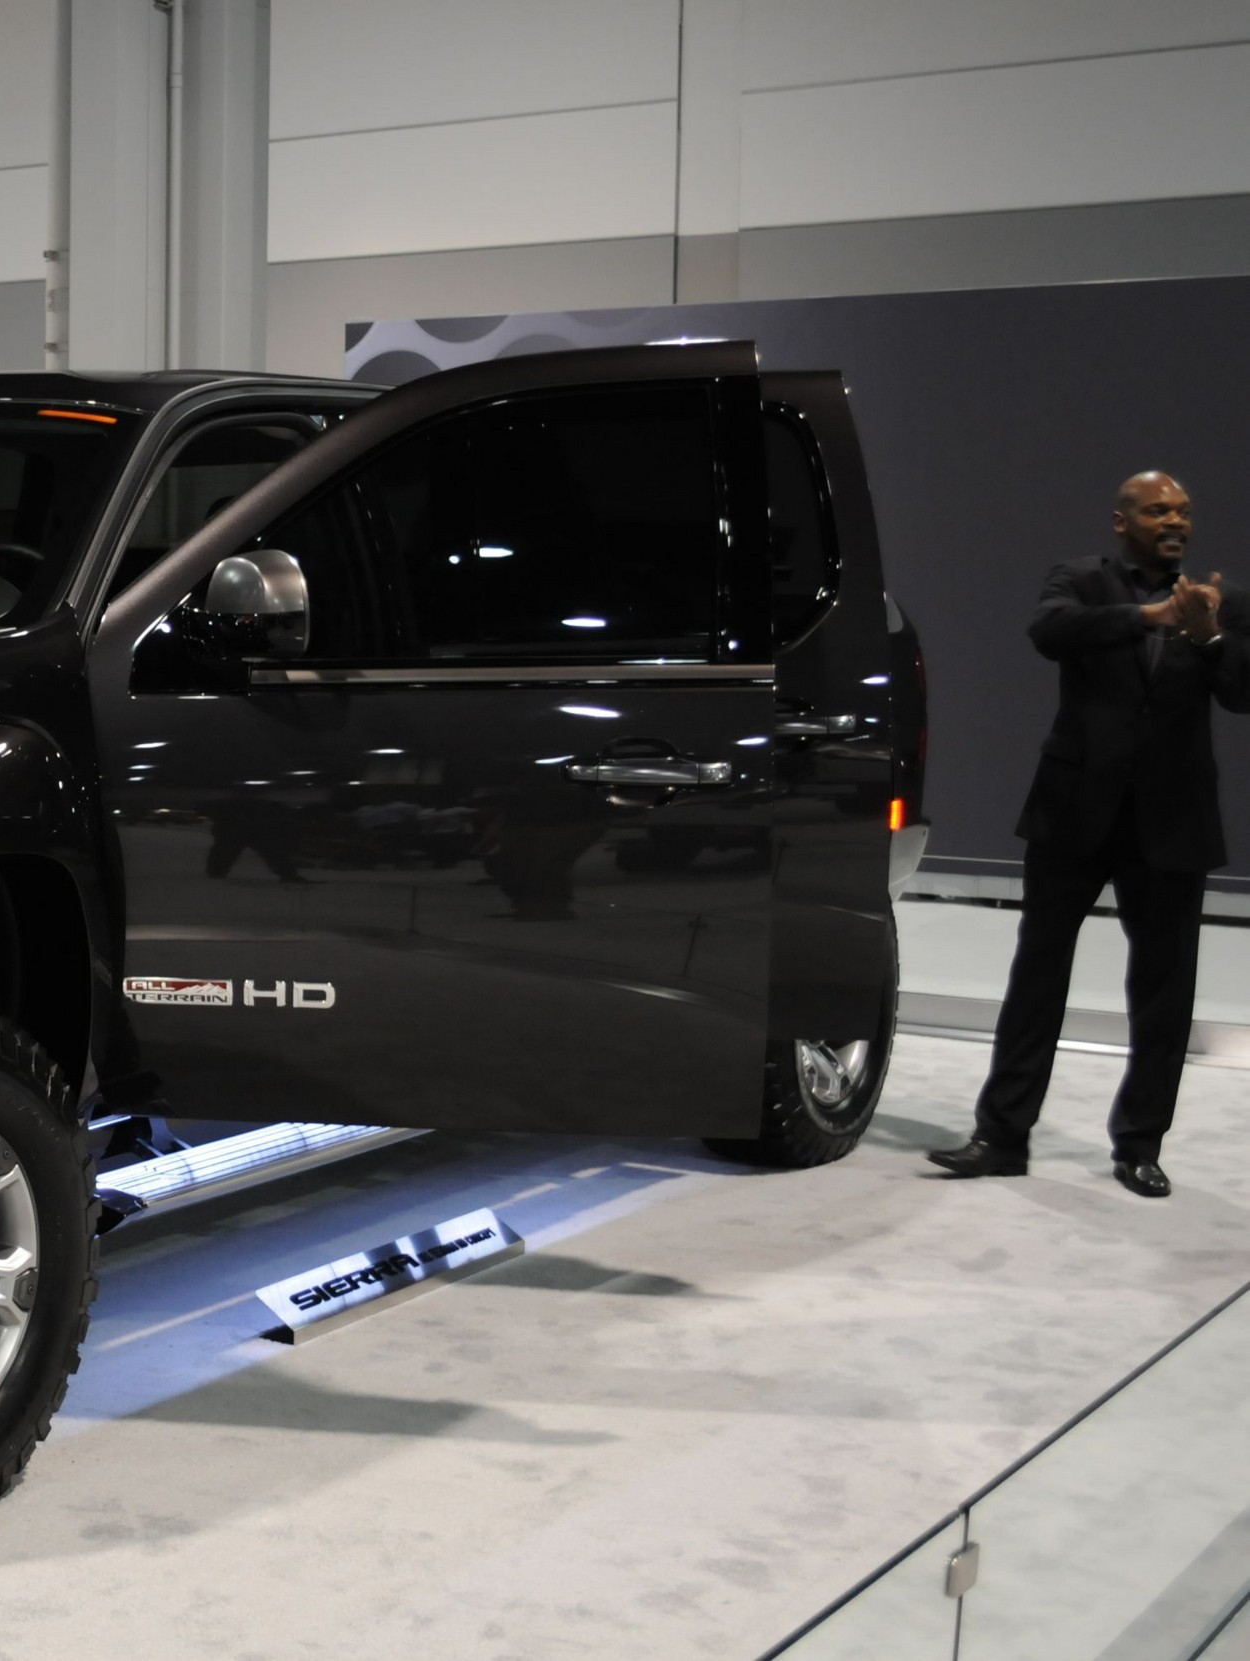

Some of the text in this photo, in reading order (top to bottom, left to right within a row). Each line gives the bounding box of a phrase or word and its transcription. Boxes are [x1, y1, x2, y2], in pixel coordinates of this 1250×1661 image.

[131, 981, 176, 991] ALL
[243, 979, 336, 1008] HD
[126, 993, 228, 1003] TERRAIN
[289, 1253, 420, 1311] SIERRA
